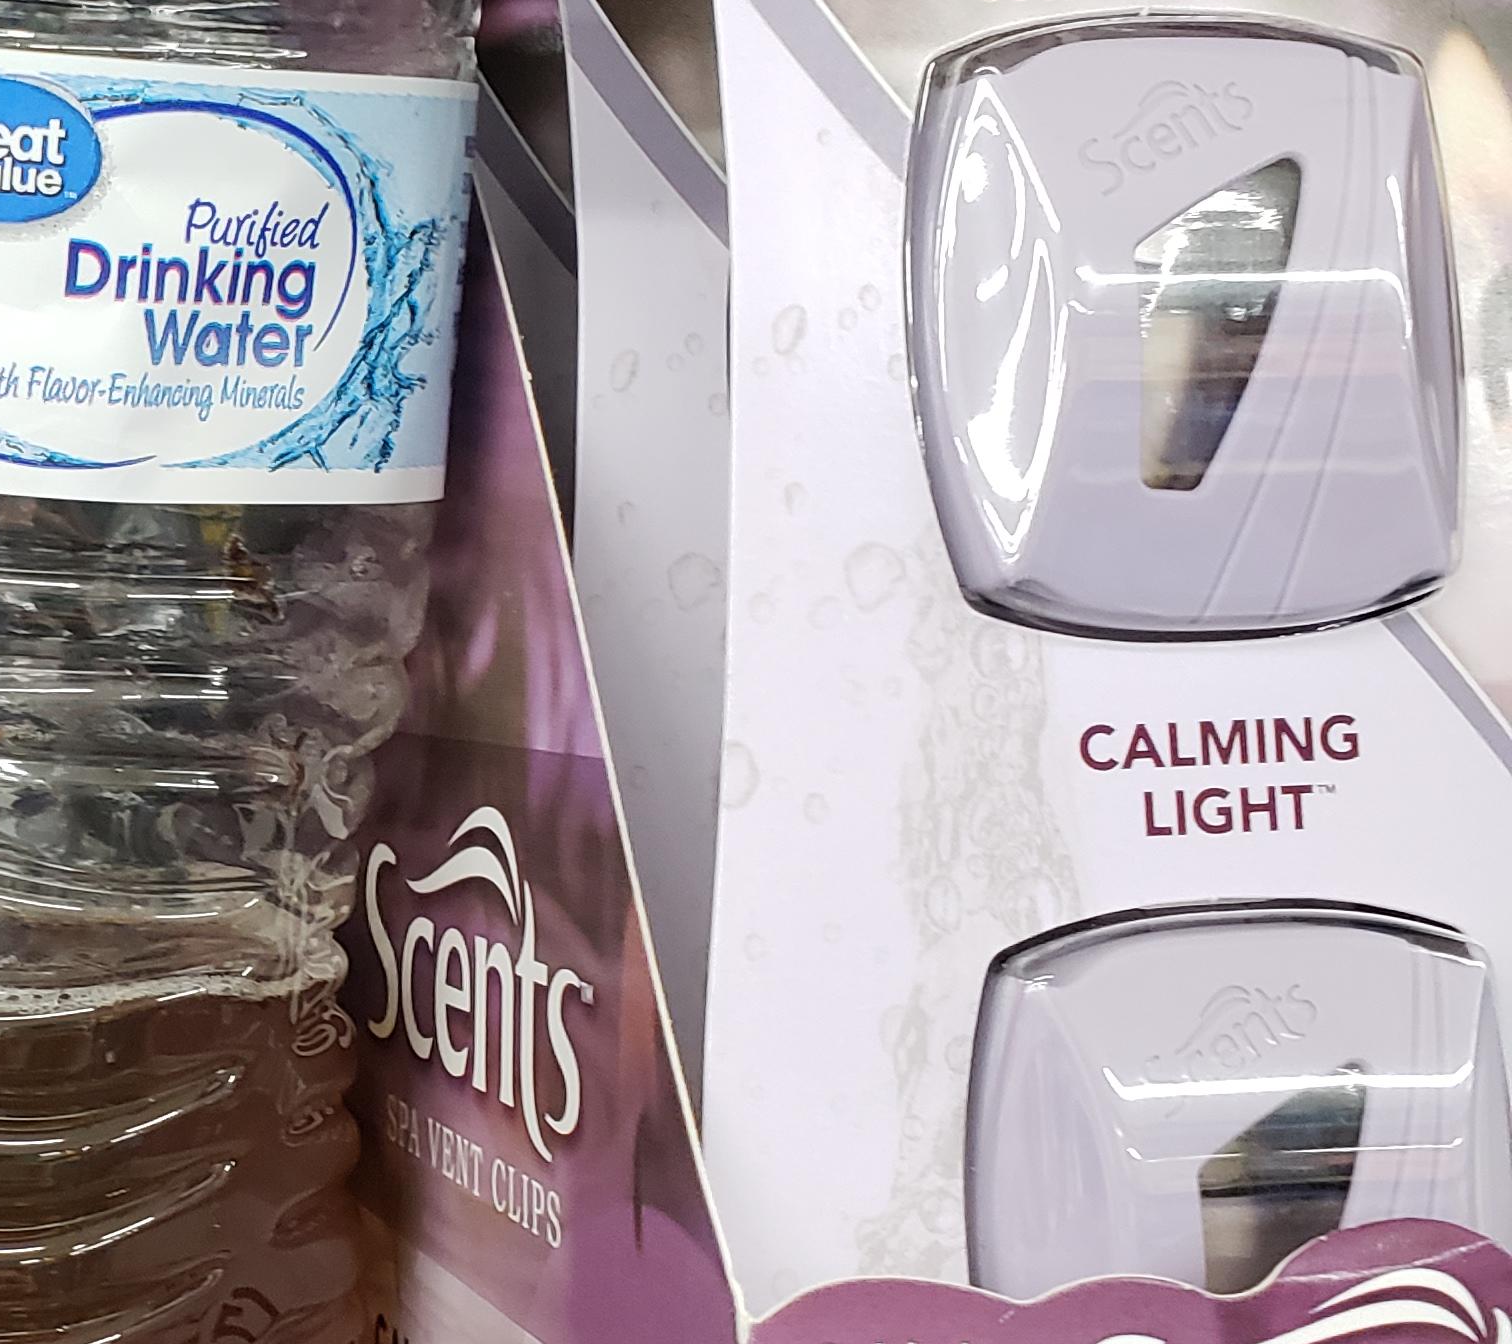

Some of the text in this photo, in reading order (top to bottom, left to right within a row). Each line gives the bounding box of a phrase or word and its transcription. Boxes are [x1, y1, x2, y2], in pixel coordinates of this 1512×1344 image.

[1078, 80, 1254, 197] Scents
[184, 197, 330, 259] Purified
[64, 237, 317, 321] Drinking
[143, 308, 315, 369] Water
[26, 365, 214, 423] Flavor-Enhancing
[220, 374, 306, 410] Minerals
[1079, 713, 1360, 771] CALMING
[1143, 783, 1315, 837] LIGHT
[365, 842, 582, 1163] Scents
[388, 1092, 562, 1249] SPA VENT CLIPS
